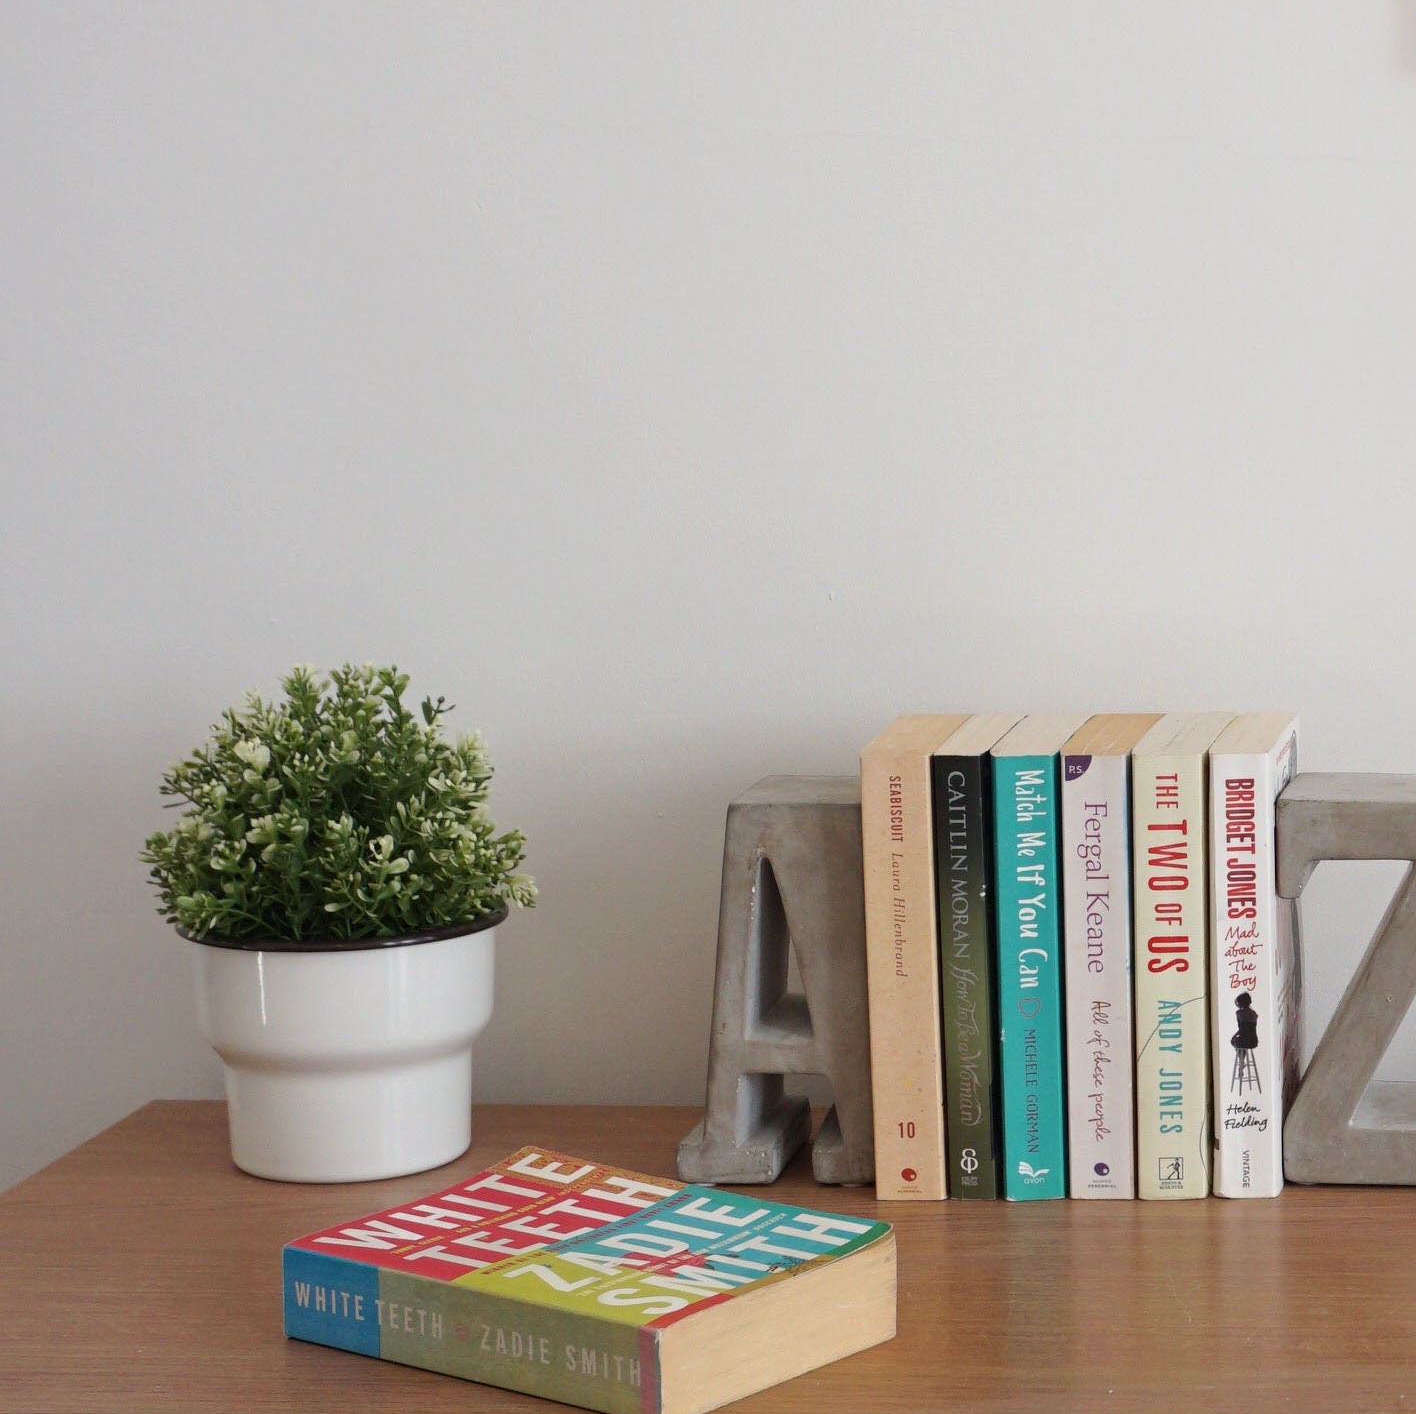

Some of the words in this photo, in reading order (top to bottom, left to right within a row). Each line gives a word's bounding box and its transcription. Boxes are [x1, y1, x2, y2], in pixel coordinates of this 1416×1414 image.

[888, 775, 904, 843] SEABISCUIT
[1015, 770, 1047, 822] Match
[1155, 773, 1179, 809] THE
[1225, 778, 1256, 854] BRIDGET
[947, 770, 968, 872] CAITLIN
[1017, 832, 1046, 857] Me
[1077, 801, 1110, 882] Fergal
[891, 853, 904, 892] Laura
[1017, 864, 1046, 887] If
[1147, 819, 1189, 891] TWO
[1226, 858, 1257, 919] JONES
[893, 898, 908, 977] Hillenbrand
[951, 879, 970, 959] MORAN
[1018, 893, 1046, 938] You
[1085, 891, 1110, 974] Keane
[1154, 903, 1183, 926] OF
[1225, 921, 1260, 941] Mad
[1018, 948, 1049, 988] Can
[1147, 936, 1189, 974] US
[1224, 943, 1263, 957] about
[1229, 960, 1257, 973] The
[951, 964, 979, 1003] How
[1229, 974, 1257, 991] Boy
[1091, 1001, 1112, 1025] All
[1157, 1000, 1183, 1054] ANDY
[1024, 1029, 1038, 1087] MICHELE
[1087, 1029, 1110, 1048] of
[959, 1051, 981, 1127] Woman
[1093, 1047, 1112, 1088] these
[1026, 1094, 1040, 1153] GORMAN
[1088, 1093, 1112, 1143] people
[1158, 1068, 1183, 1134] JONES
[1224, 1117, 1268, 1132] Fielding
[1226, 1104, 1261, 1115] Helen
[898, 1121, 916, 1139] 10
[1023, 1177, 1045, 1185] avon
[1241, 1150, 1251, 1188] VINTAGE
[312, 1153, 597, 1251] WHITE
[402, 1175, 680, 1268] TEETH
[503, 1197, 772, 1292] ZADIE
[597, 1213, 874, 1315] SMITH
[295, 1280, 365, 1322] WHITE
[374, 1298, 443, 1340] TEETH
[480, 1324, 550, 1365] ZADIE
[565, 1344, 642, 1387] SMITH
